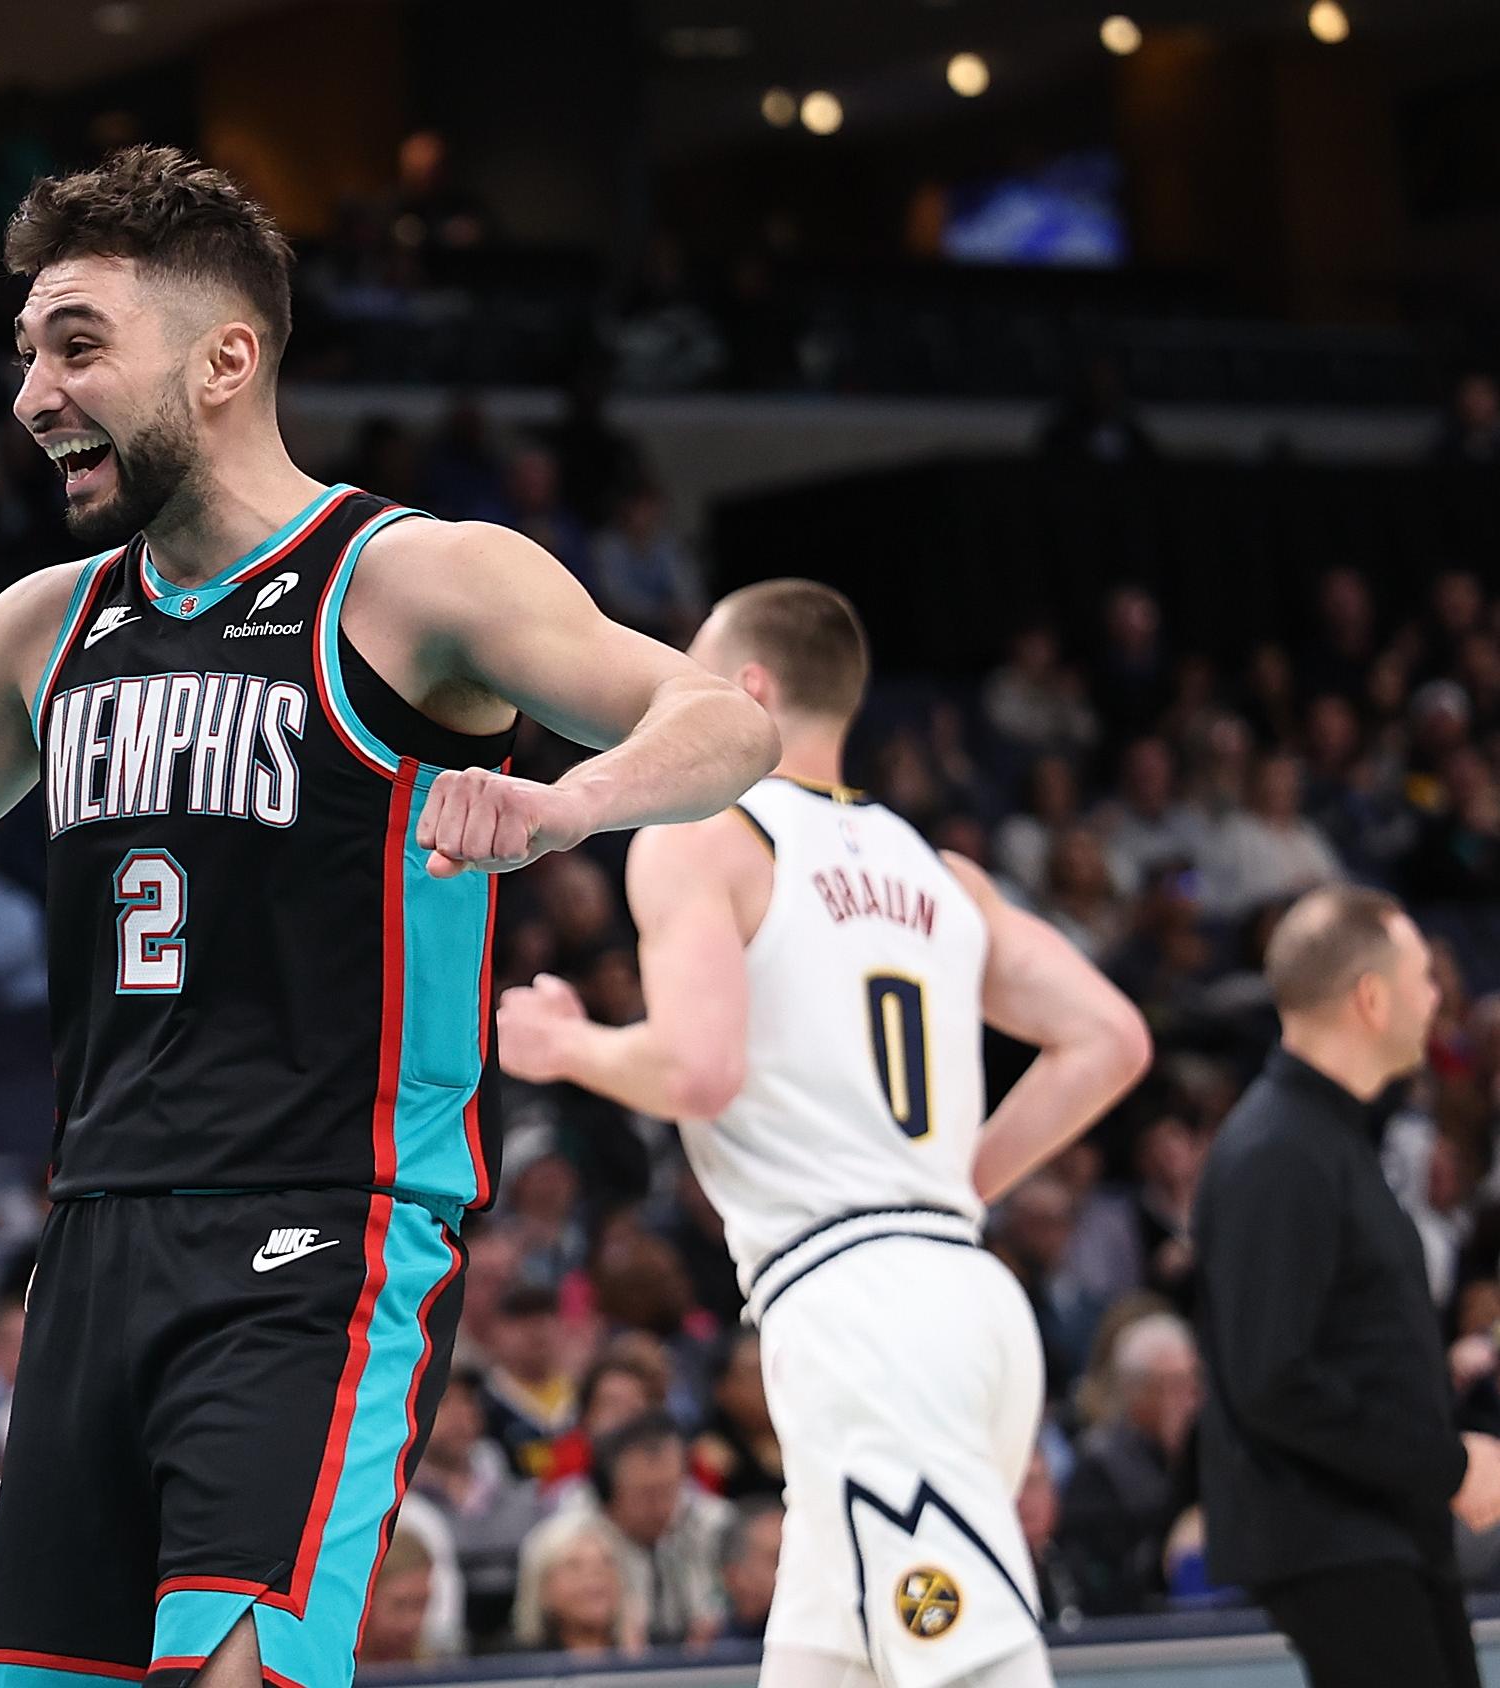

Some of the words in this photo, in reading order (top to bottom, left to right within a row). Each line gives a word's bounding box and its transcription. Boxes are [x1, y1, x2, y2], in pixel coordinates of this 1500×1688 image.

[93, 606, 132, 631] NIKE
[223, 620, 303, 640] Robinhood
[48, 671, 308, 840] MEMPHIS
[113, 848, 187, 995] 2
[813, 867, 934, 936] BRAUN
[263, 1228, 320, 1255] NIKE
